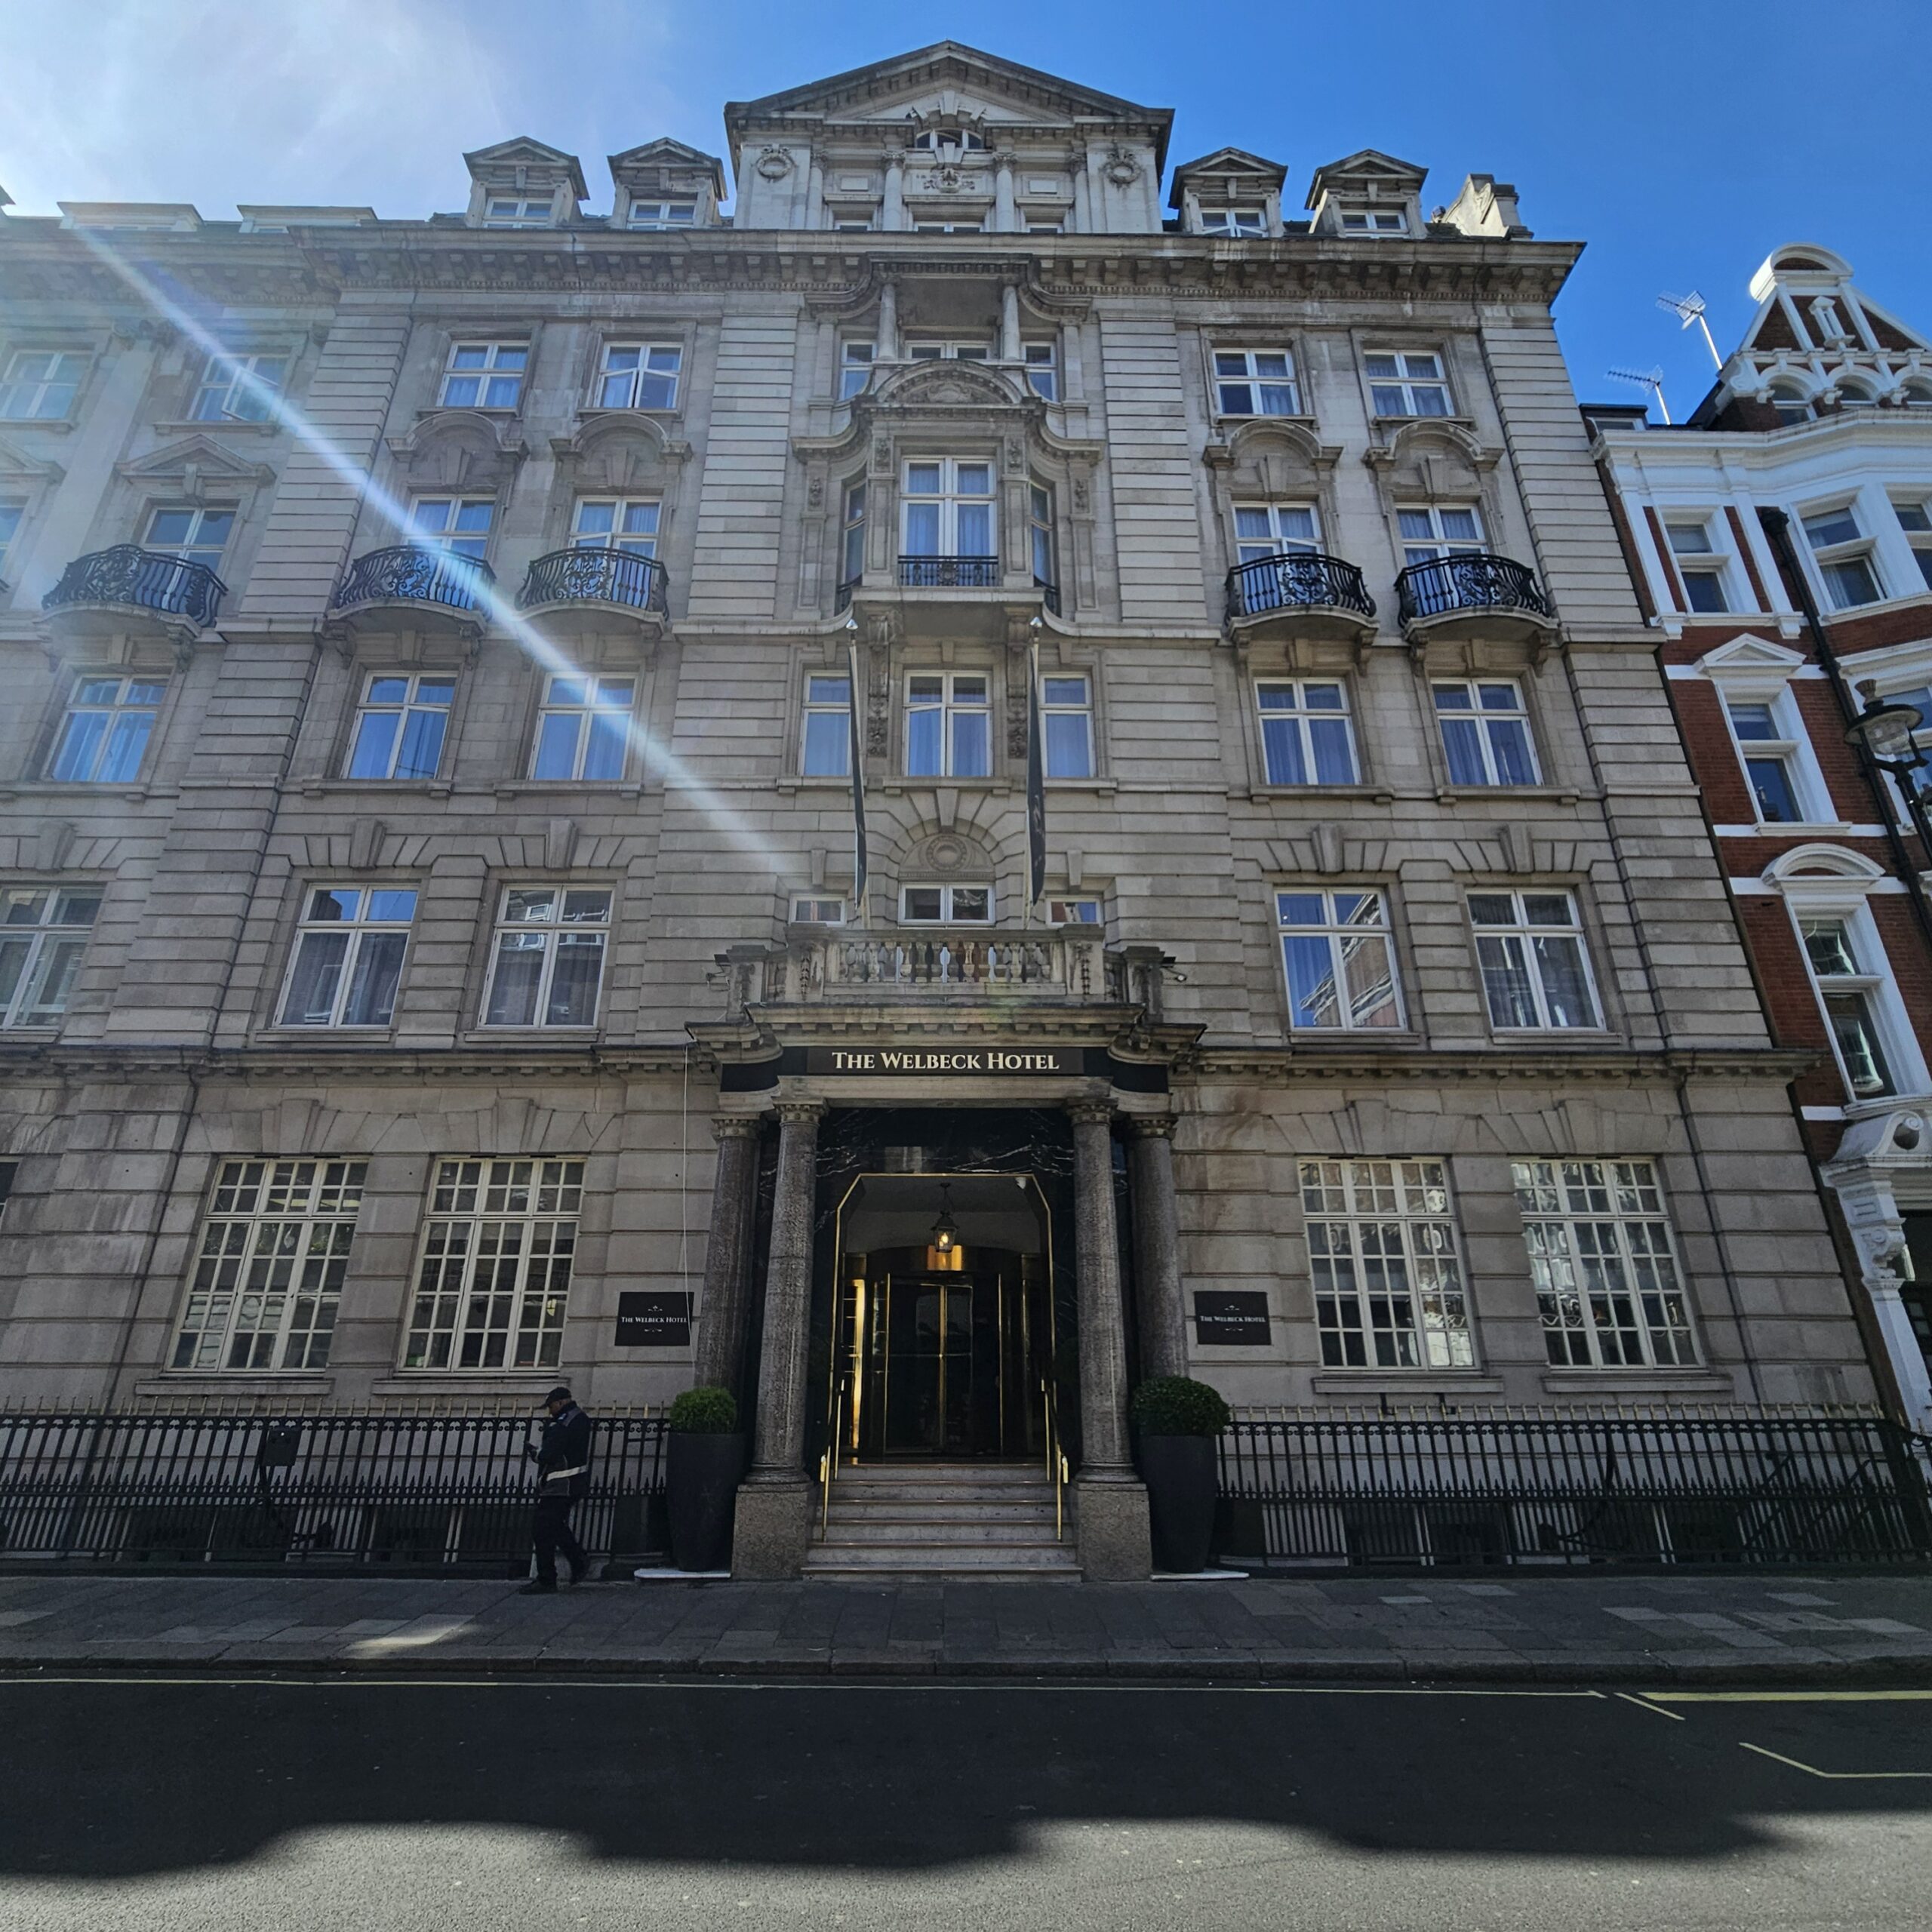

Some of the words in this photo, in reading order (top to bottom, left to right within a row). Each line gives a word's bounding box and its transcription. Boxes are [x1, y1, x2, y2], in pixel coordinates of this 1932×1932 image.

[832, 1052, 875, 1069] THE
[881, 1052, 980, 1069] WELBECK
[987, 1052, 1060, 1069] HOTEL
